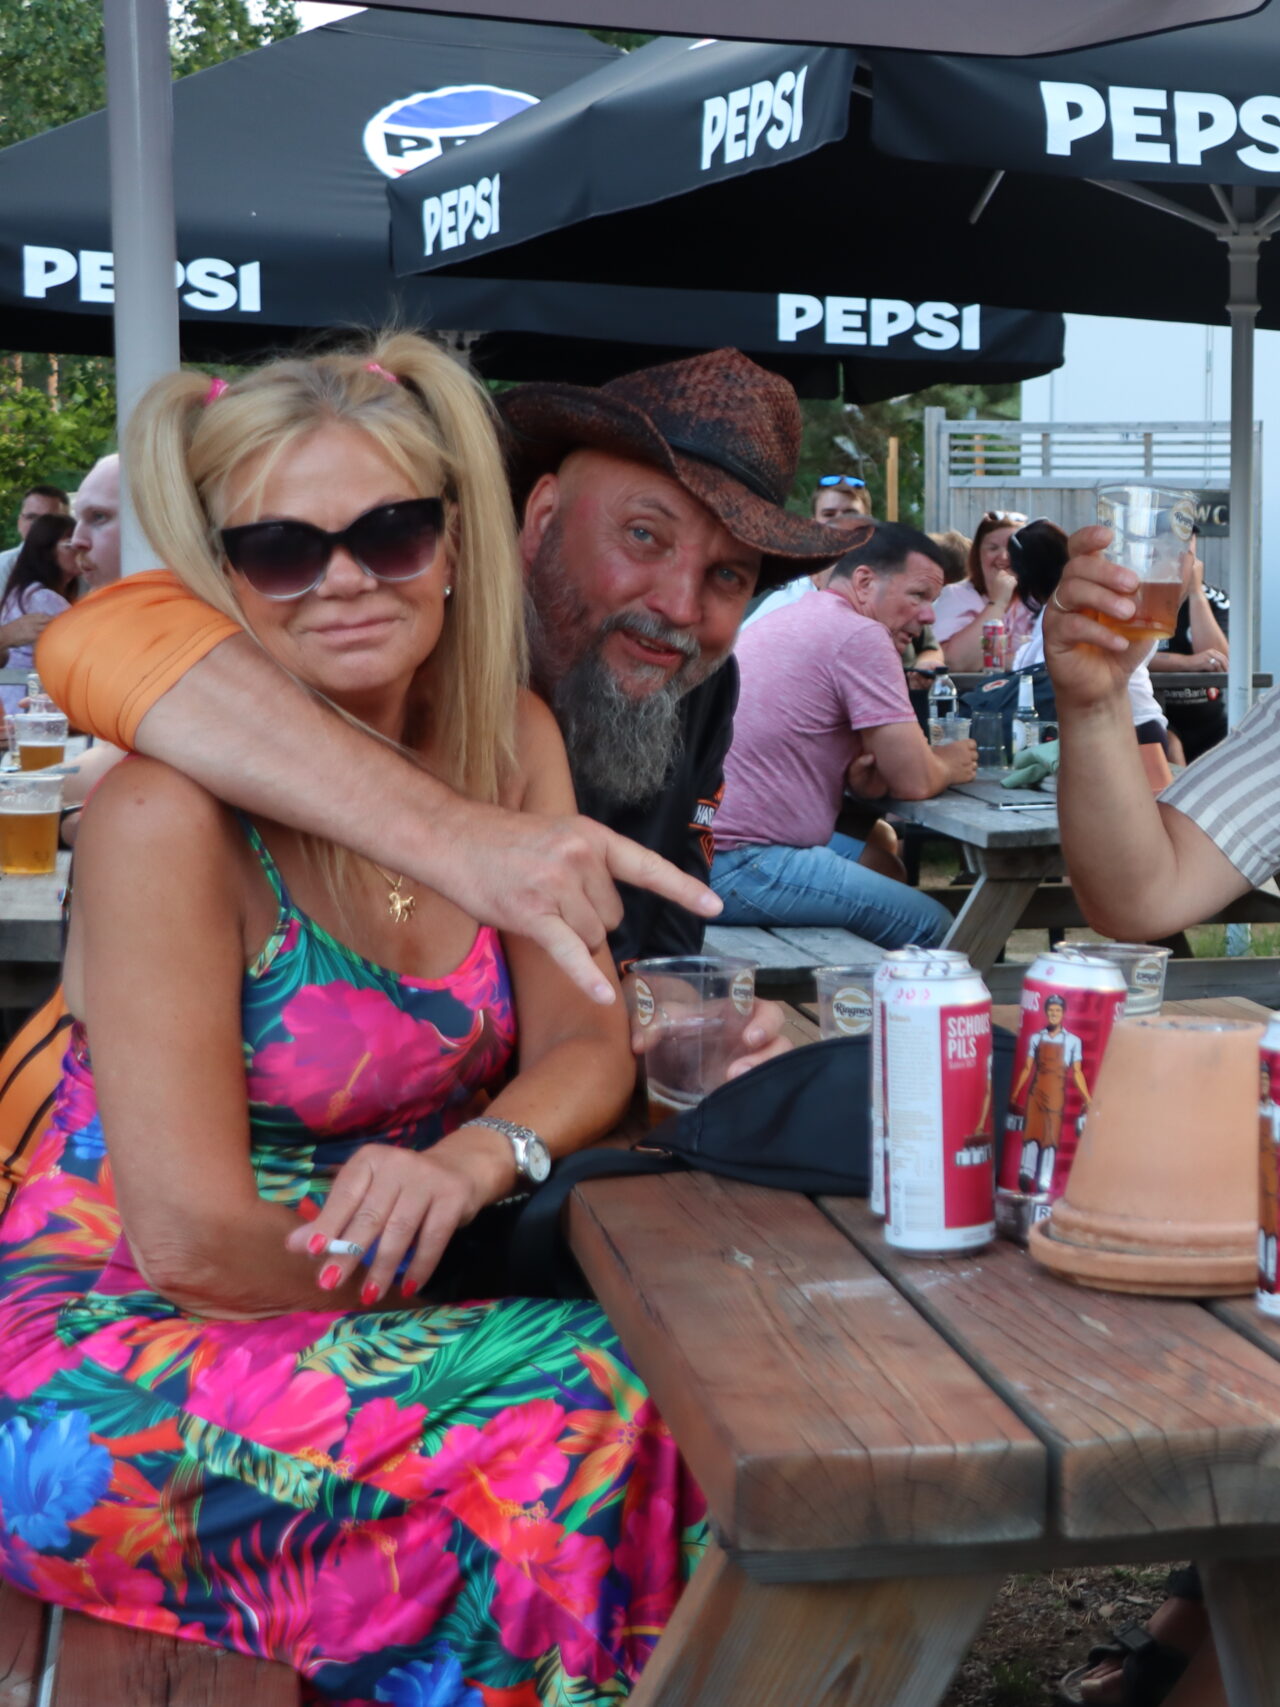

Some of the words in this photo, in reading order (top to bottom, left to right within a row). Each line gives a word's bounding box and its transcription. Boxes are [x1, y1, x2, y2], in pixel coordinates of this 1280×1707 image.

[701, 65, 808, 170] PEPSI
[423, 172, 500, 256] PEPSI
[23, 245, 261, 312] PESI
[777, 293, 980, 350] PEPSI
[1194, 504, 1228, 526] WC
[947, 1013, 990, 1038] SCHOUS
[947, 1037, 977, 1059] PILS
